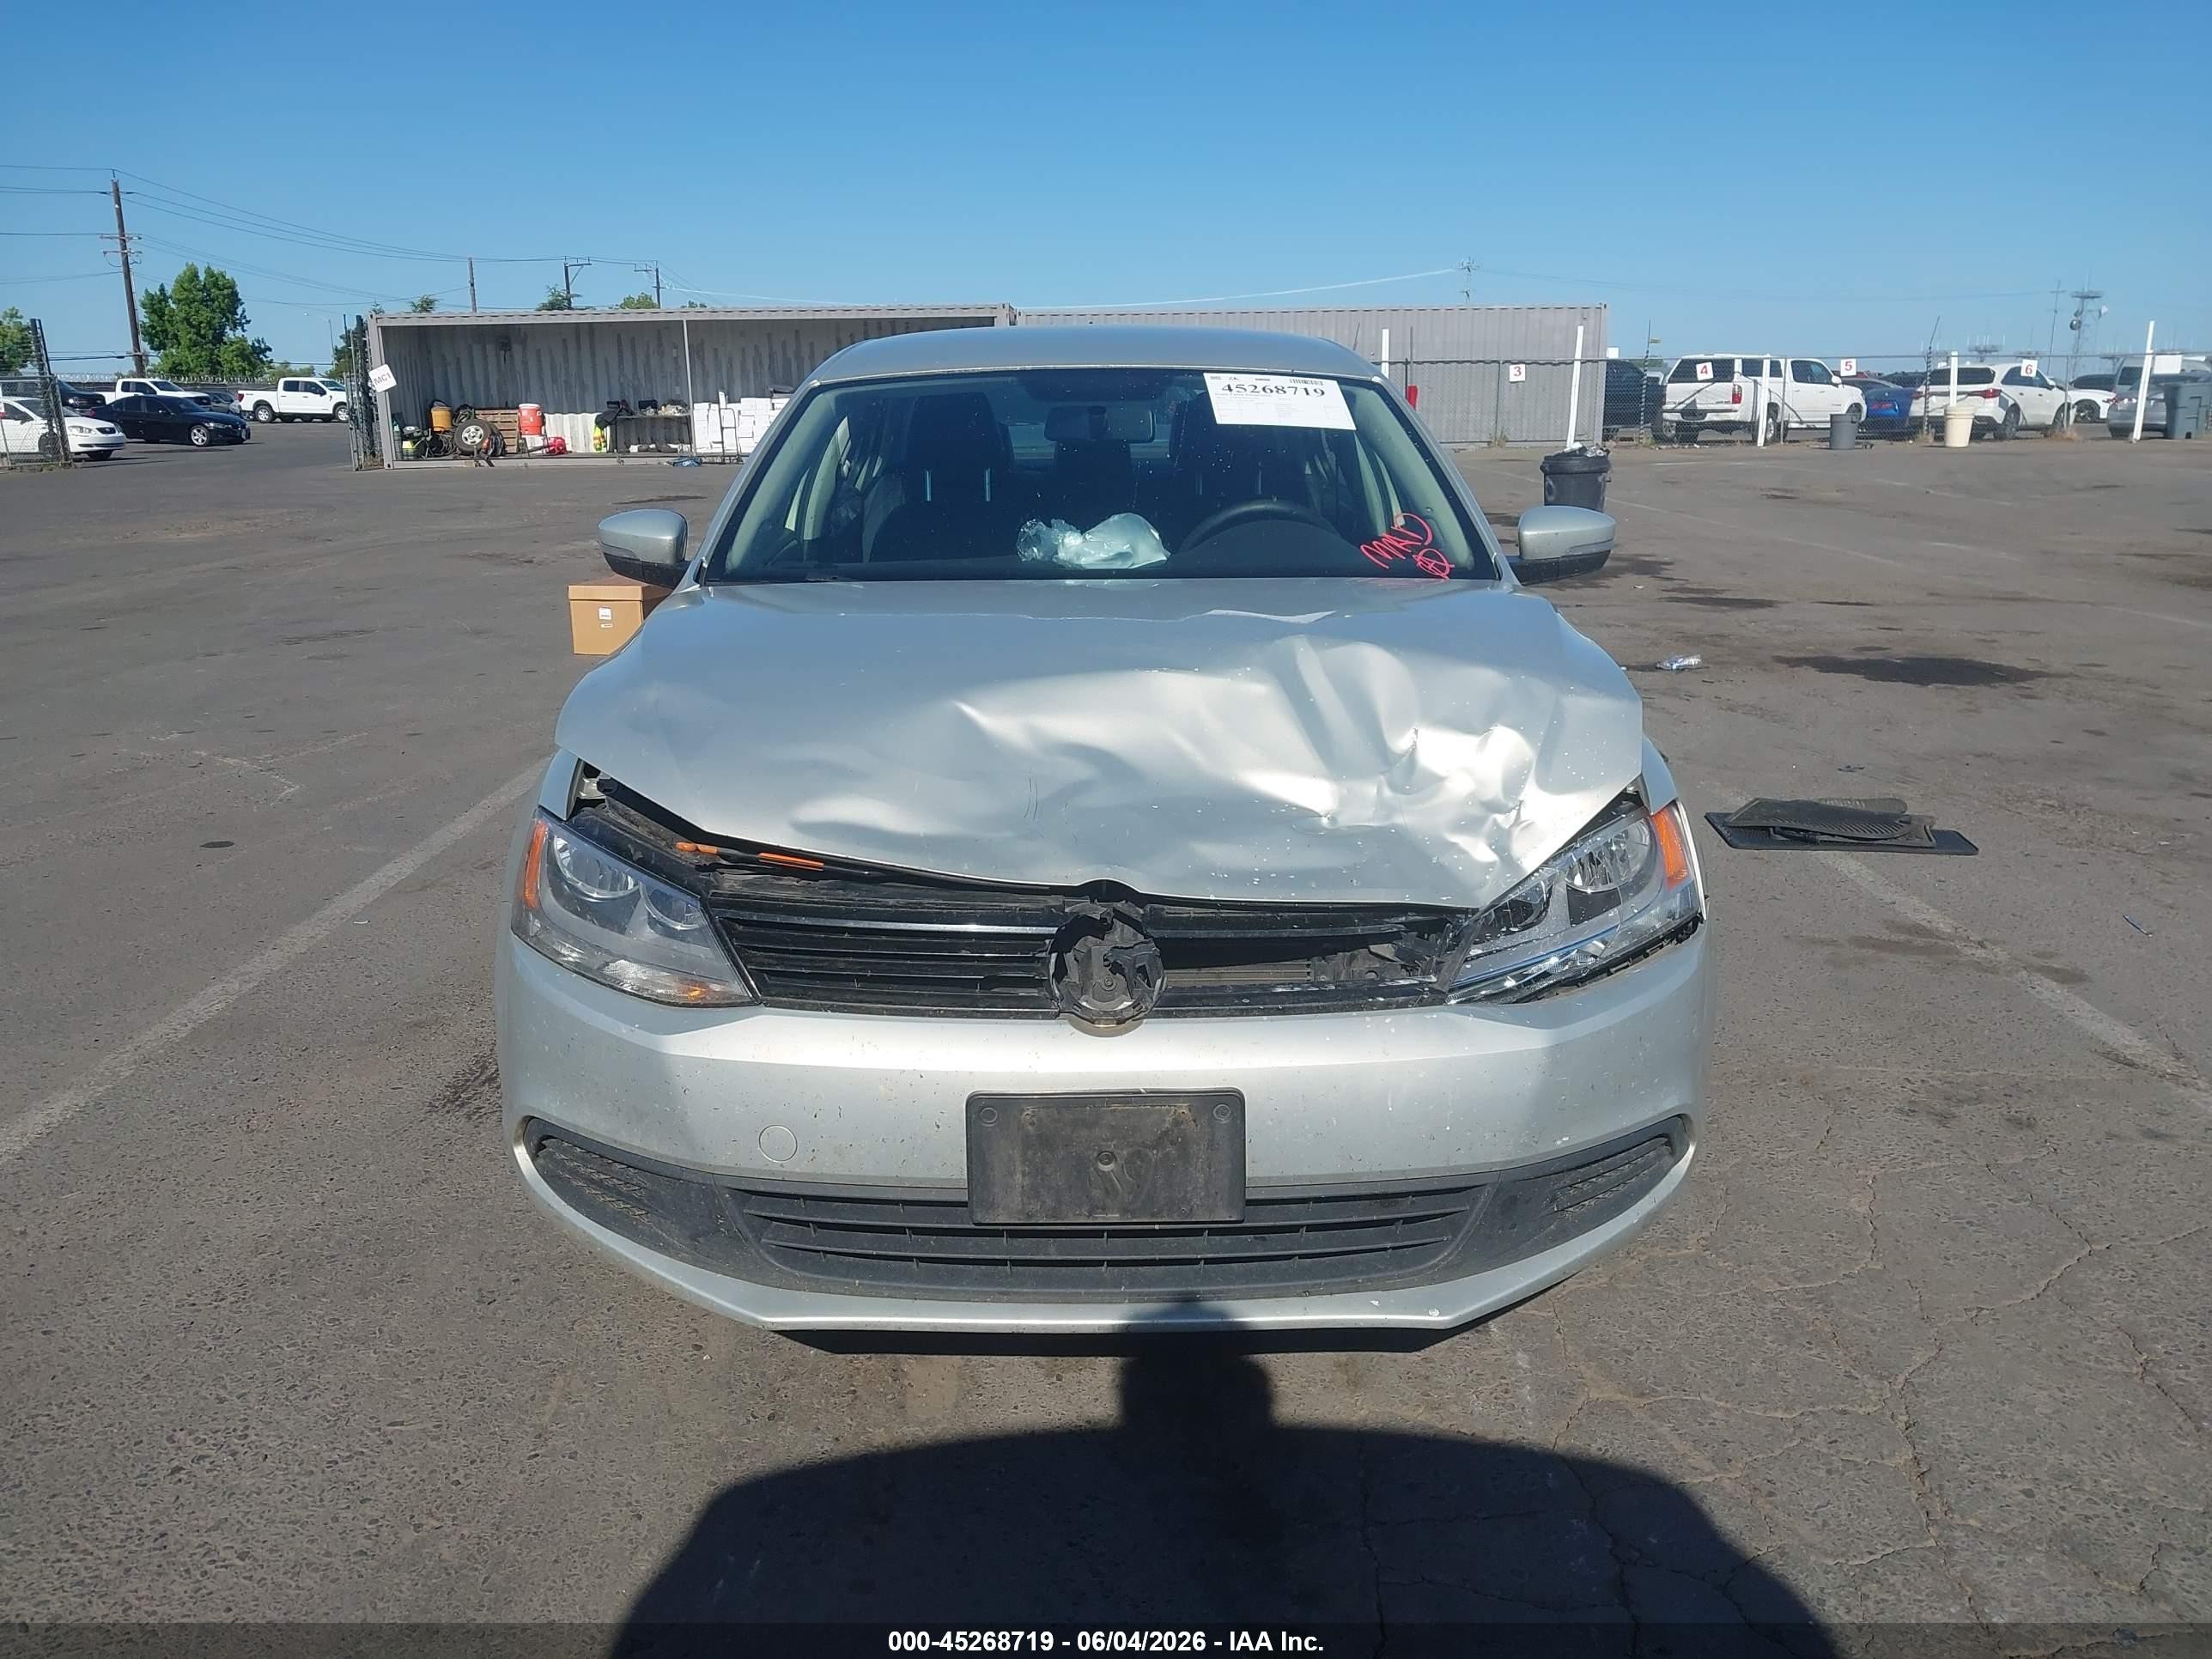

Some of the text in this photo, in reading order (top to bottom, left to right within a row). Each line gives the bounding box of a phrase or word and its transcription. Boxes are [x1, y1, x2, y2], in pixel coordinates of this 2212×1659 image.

[1513, 366, 1522, 377] 3
[1699, 365, 1709, 376] 4
[1844, 361, 1853, 371] 5
[2025, 363, 2033, 375] 6
[374, 372, 392, 386] MC1
[1221, 383, 1326, 398] 45268719
